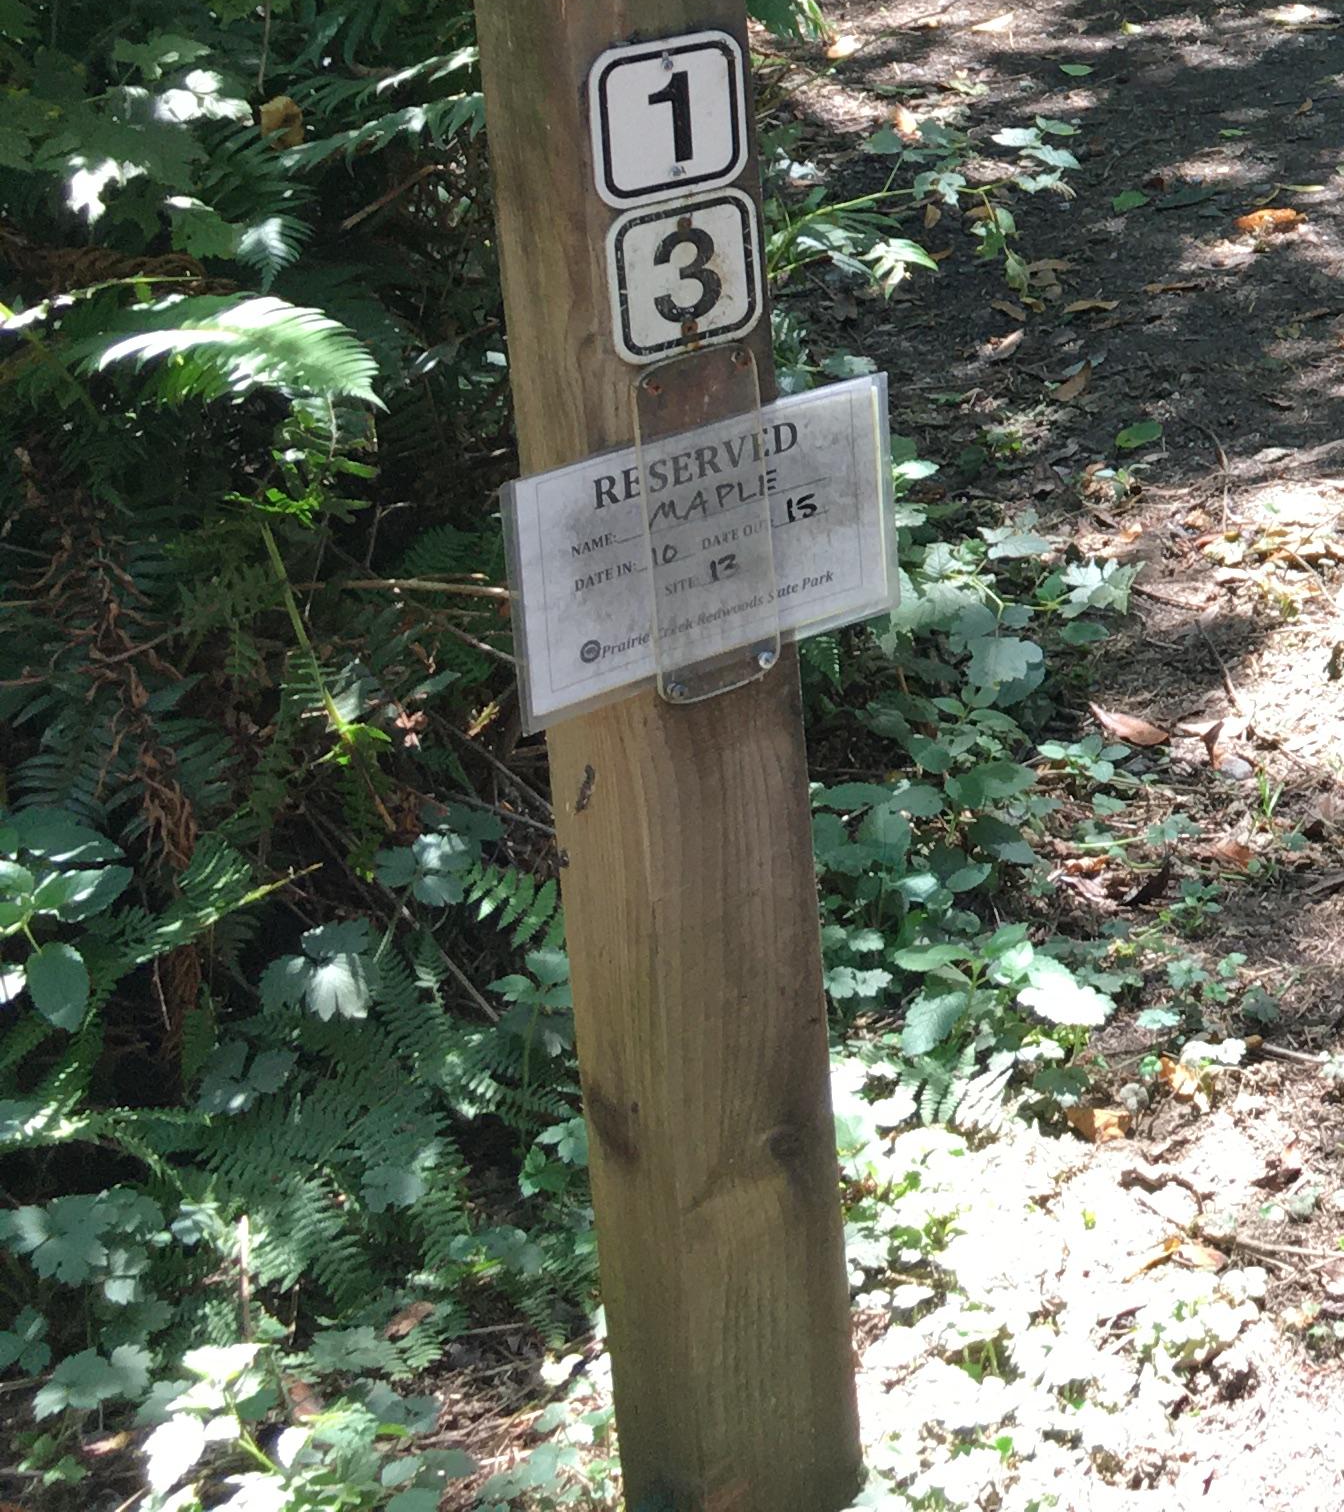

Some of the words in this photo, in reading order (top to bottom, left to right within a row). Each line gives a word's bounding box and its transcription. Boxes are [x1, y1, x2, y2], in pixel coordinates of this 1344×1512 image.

[647, 70, 694, 163] 1
[653, 226, 722, 324] 3
[592, 421, 798, 510] RESERVED
[571, 532, 617, 558] NAME:
[648, 468, 777, 531] MAPLE
[574, 568, 613, 593] DATE
[651, 544, 678, 566] 10
[701, 529, 739, 551] DATE
[786, 493, 818, 524] 15
[601, 631, 650, 660] Prairie
[697, 593, 765, 626] Redwoods
[767, 582, 799, 605] Sate
[801, 569, 834, 593] Park
